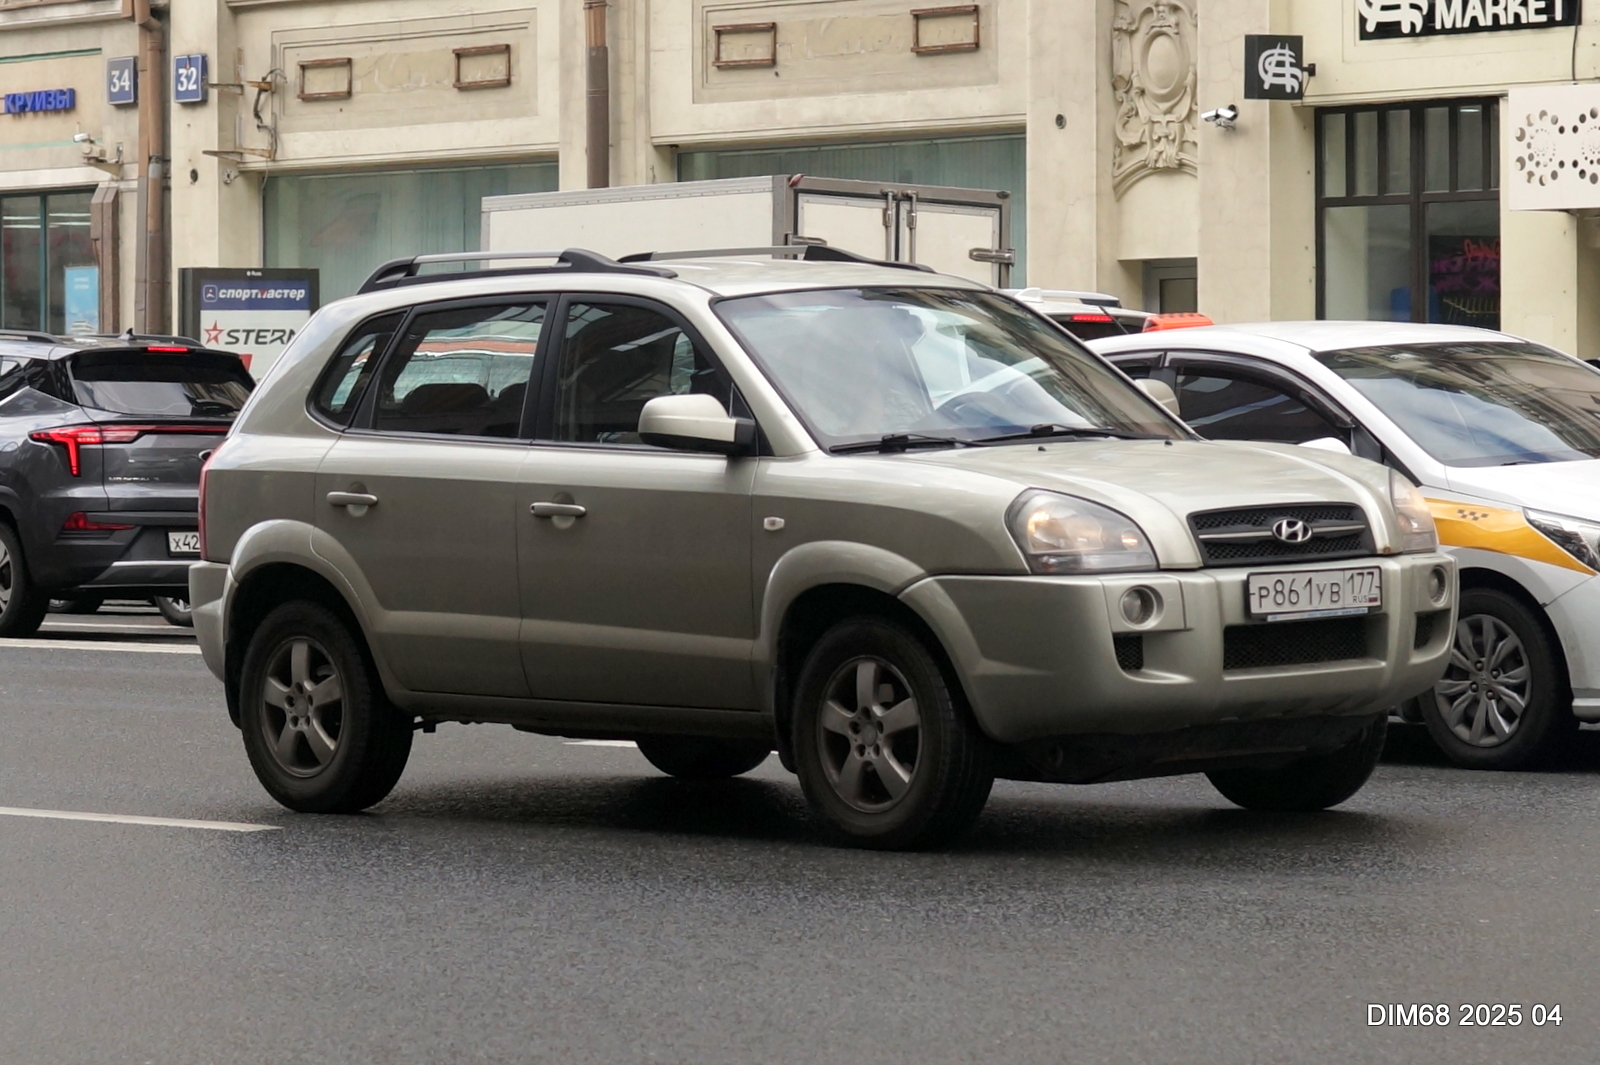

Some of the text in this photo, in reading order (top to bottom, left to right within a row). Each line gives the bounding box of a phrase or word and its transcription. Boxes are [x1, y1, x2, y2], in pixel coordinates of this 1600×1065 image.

[110, 68, 130, 92] 34
[177, 66, 197, 91] 32
[4, 88, 75, 113] КРУИЗЫ
[219, 288, 306, 301] спортмастер
[1347, 571, 1374, 595] 177
[1353, 595, 1367, 603] RUS
